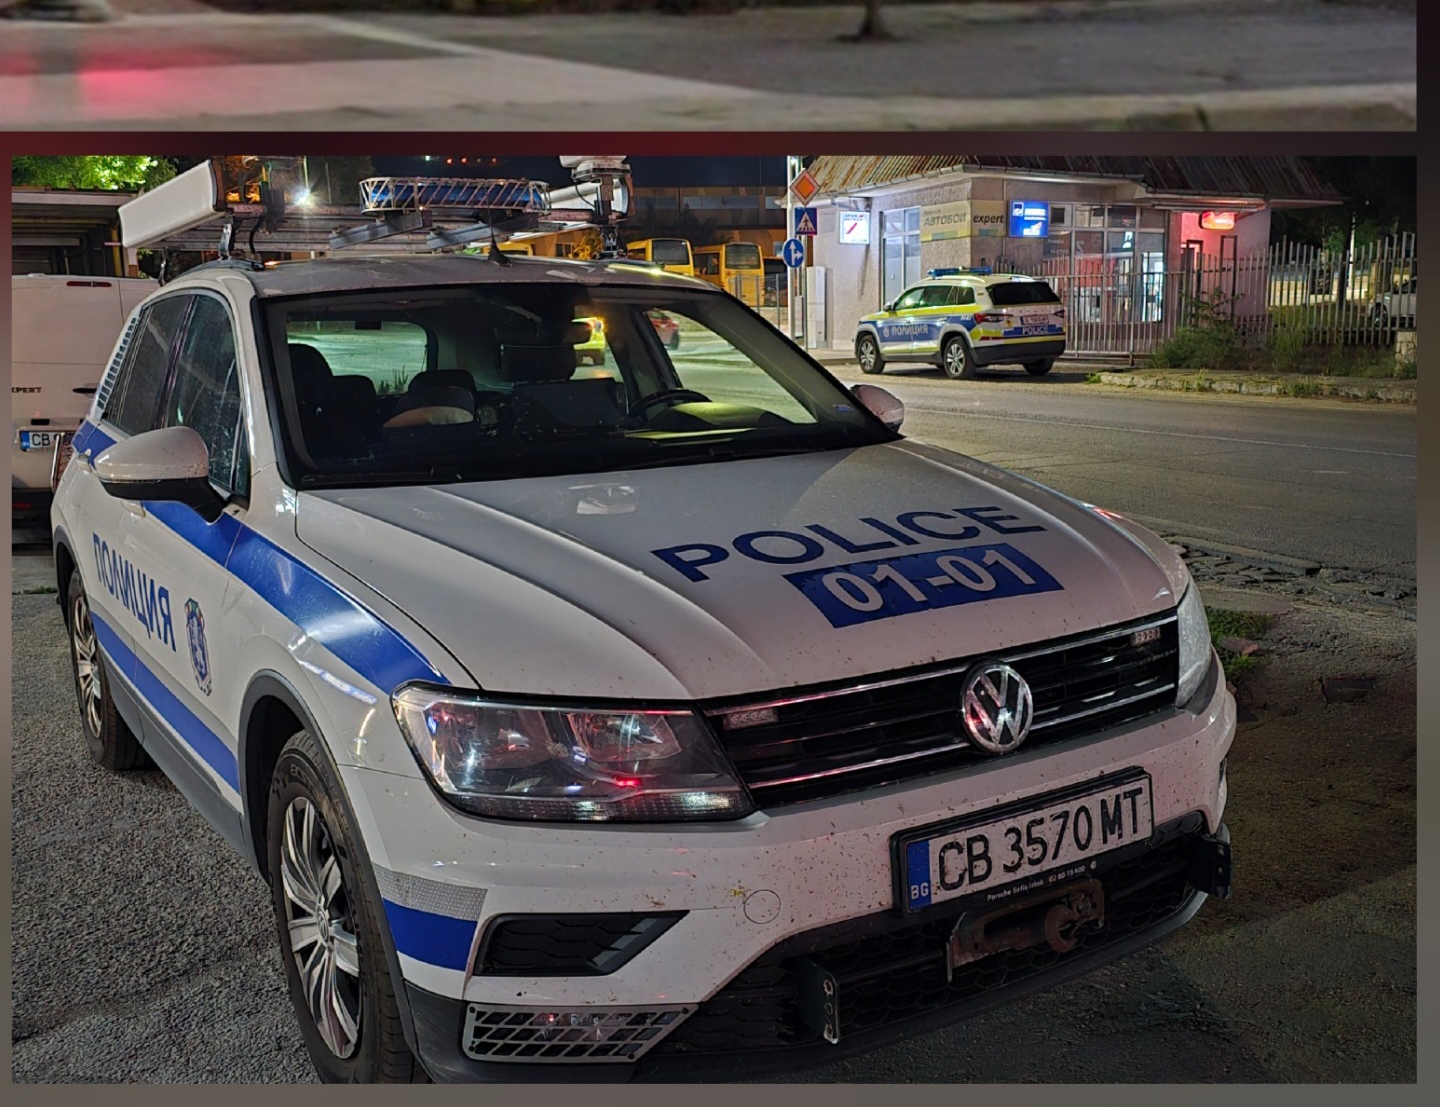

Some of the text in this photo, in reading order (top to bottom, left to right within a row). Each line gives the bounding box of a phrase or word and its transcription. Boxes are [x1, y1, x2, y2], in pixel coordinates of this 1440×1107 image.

[973, 214, 1004, 227] expert
[892, 324, 928, 337] ПОЛИЦИЯ
[1022, 326, 1049, 335] POLICE
[650, 506, 1048, 583] POLICE
[821, 548, 1038, 612] 01-01
[93, 532, 176, 652] ПОЛИЦИЯ
[938, 787, 1143, 891] CB 3570 MT
[910, 882, 930, 900] BG
[987, 889, 1011, 902] Porsche
[1012, 883, 1028, 895] Sofia
